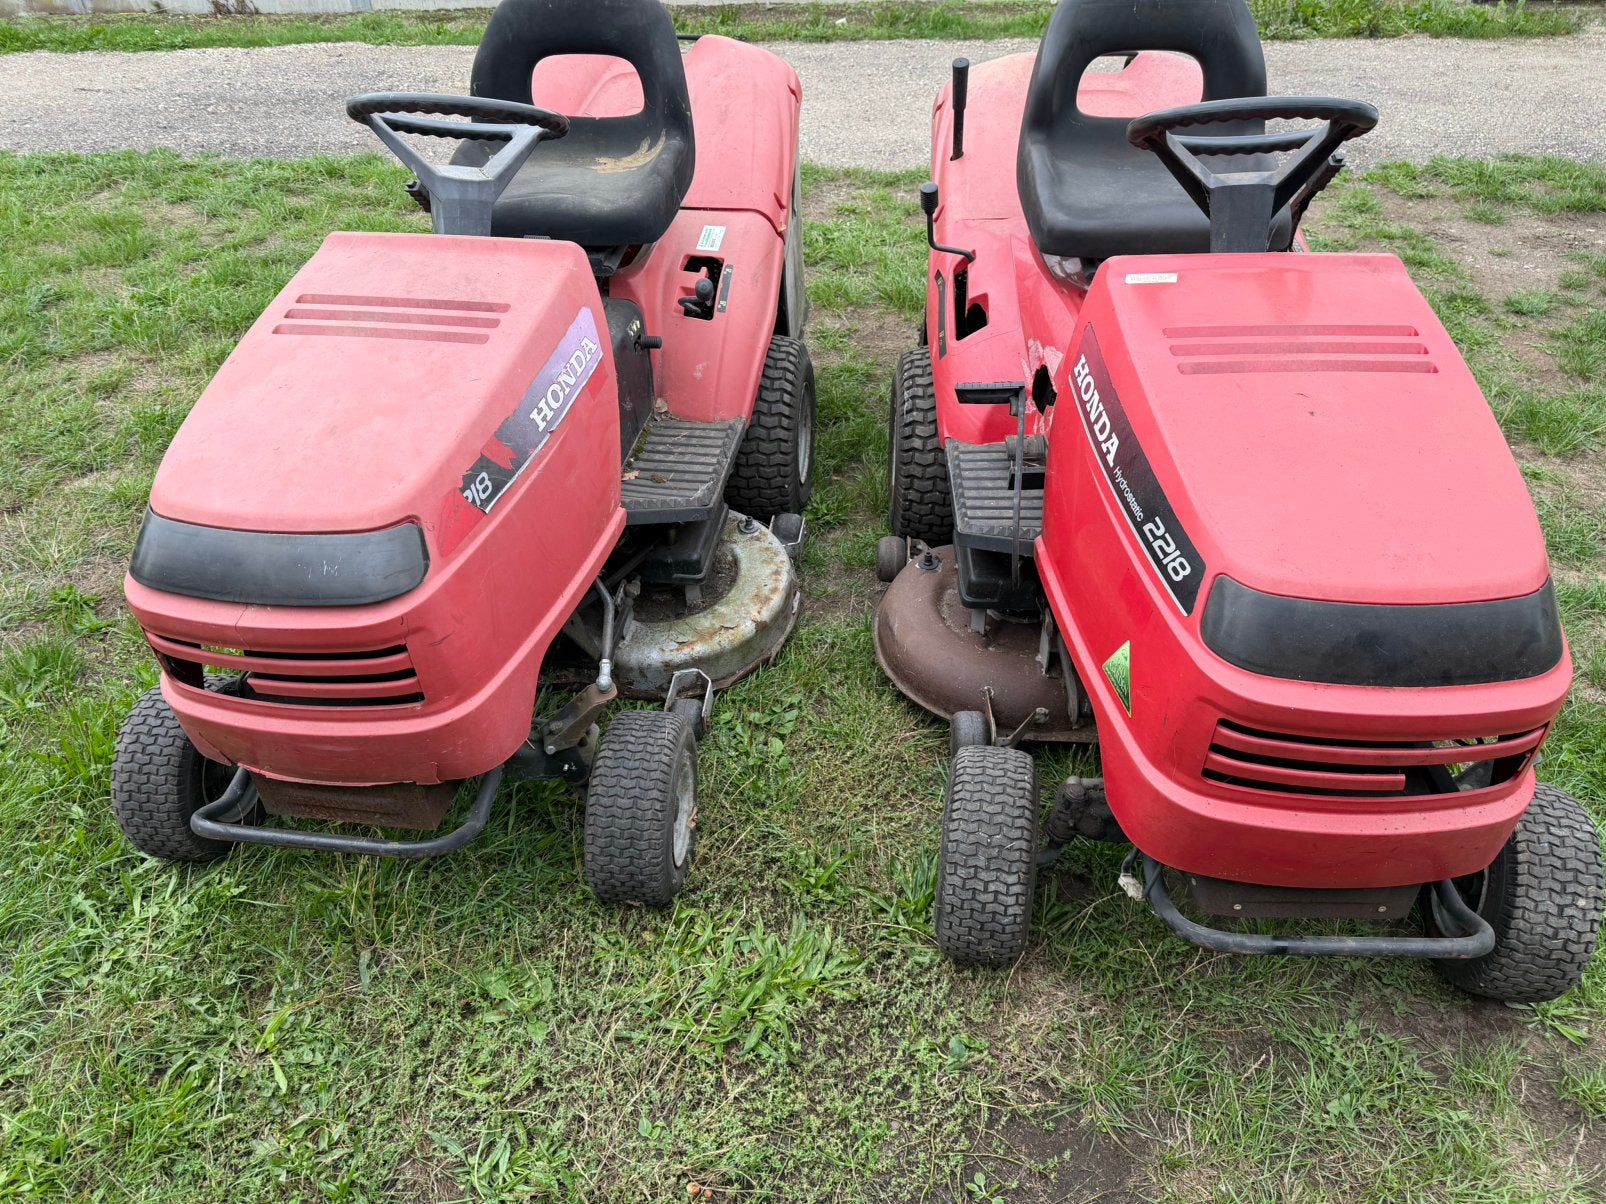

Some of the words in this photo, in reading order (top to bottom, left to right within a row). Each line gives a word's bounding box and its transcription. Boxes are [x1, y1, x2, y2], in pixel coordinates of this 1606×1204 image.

[529, 336, 598, 432] HONDA
[1074, 353, 1120, 467] HONDA
[1113, 466, 1144, 522] Hydrostatic
[1142, 516, 1192, 582] 2218
